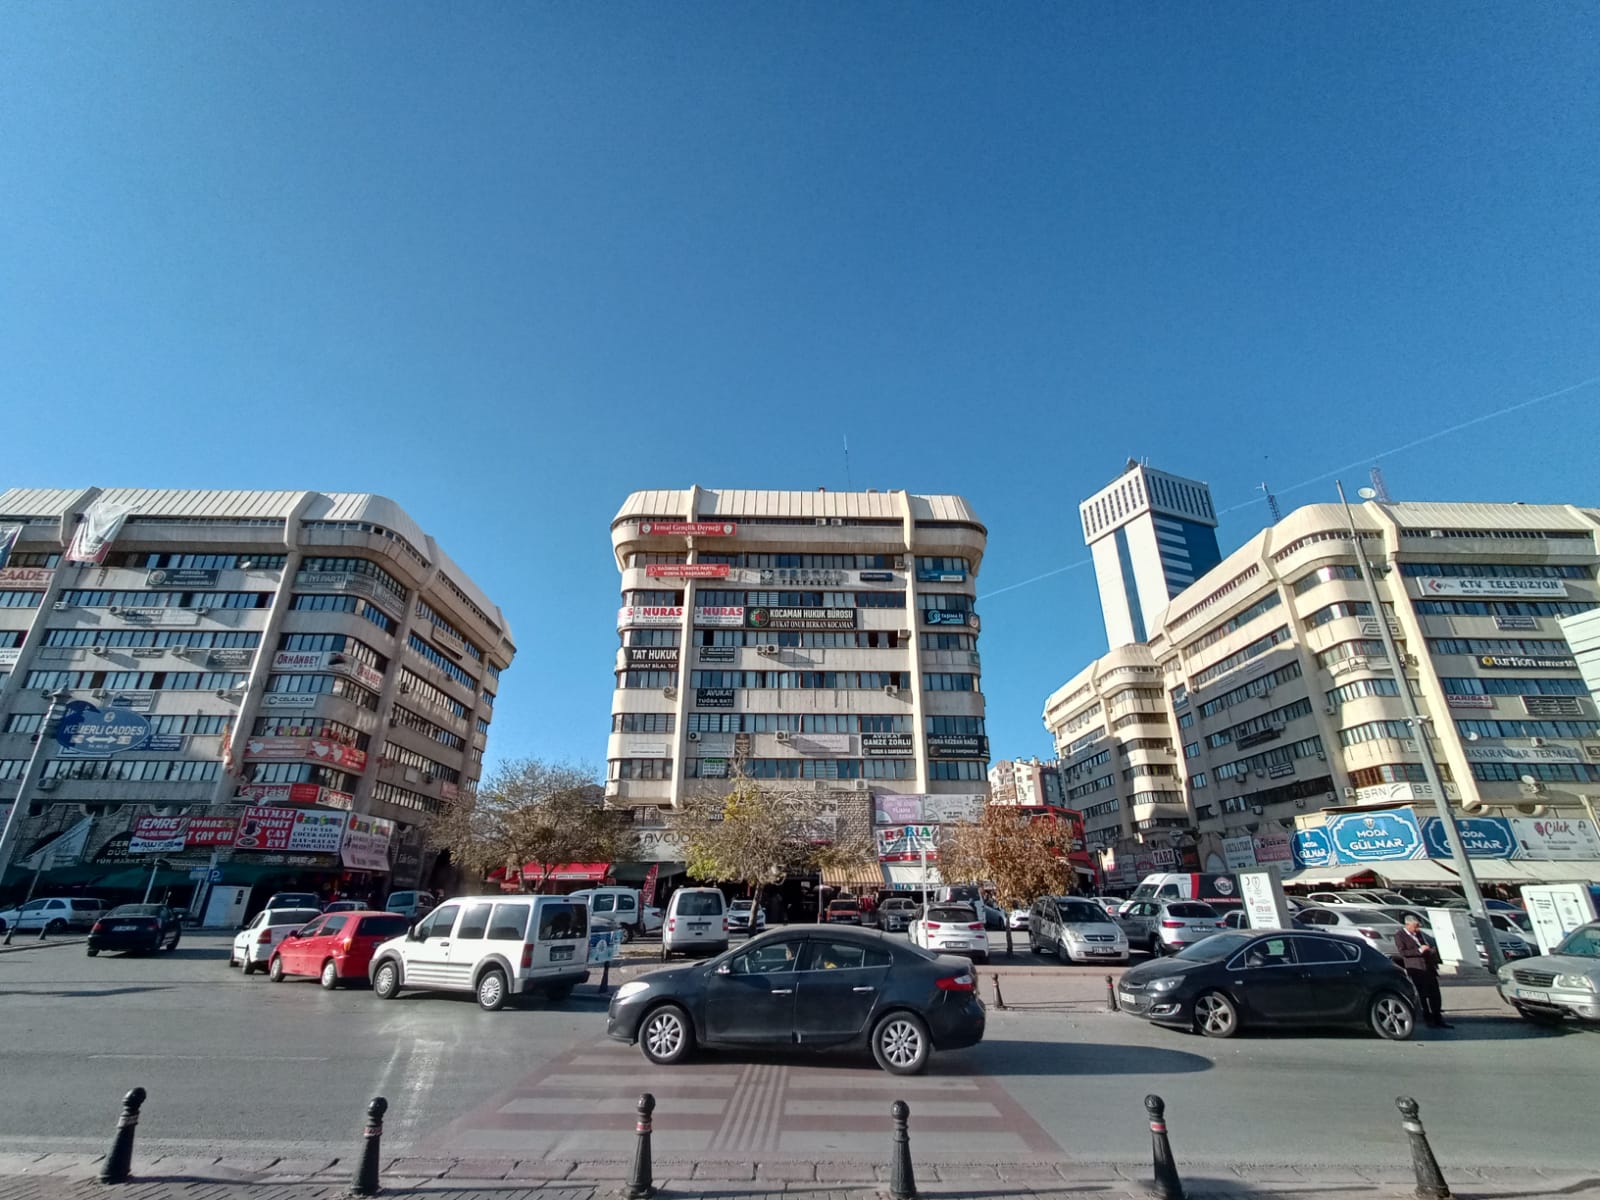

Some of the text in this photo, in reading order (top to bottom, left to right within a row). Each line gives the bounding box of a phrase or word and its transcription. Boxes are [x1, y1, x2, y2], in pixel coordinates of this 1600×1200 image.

[697, 524, 721, 532] Derneği
[1459, 580, 1559, 589] KTV TELEVİZYON
[642, 607, 683, 616] NURAS
[703, 607, 743, 616] NURAS
[769, 608, 853, 619] KOCAMAN HUKUK BÜROSU
[790, 620, 806, 628] ONUR
[827, 621, 854, 629] KOCAMAN
[277, 654, 320, 665] ORHANBEY
[632, 649, 678, 660] TAT HUKUK
[706, 689, 733, 697] AVUKAT
[105, 725, 147, 737] CADDESİ
[863, 738, 912, 746] GAMZE ZORLU
[1532, 749, 1576, 759] TERMAL
[1413, 784, 1455, 795] BSN
[247, 808, 295, 818] KAYMAZ
[142, 818, 179, 829] EMRE
[259, 818, 291, 829] SİMİT
[1356, 829, 1389, 838] MODA
[1544, 820, 1575, 839] Çilek
[195, 831, 214, 842] ÇAY
[216, 830, 232, 841] EVİ
[266, 839, 286, 849] EVİ
[1349, 839, 1405, 850] GÜLNAR
[1443, 839, 1503, 849] GLNAR
[1153, 850, 1174, 864] TARZ
[1299, 848, 1327, 858] GÜLNAR
